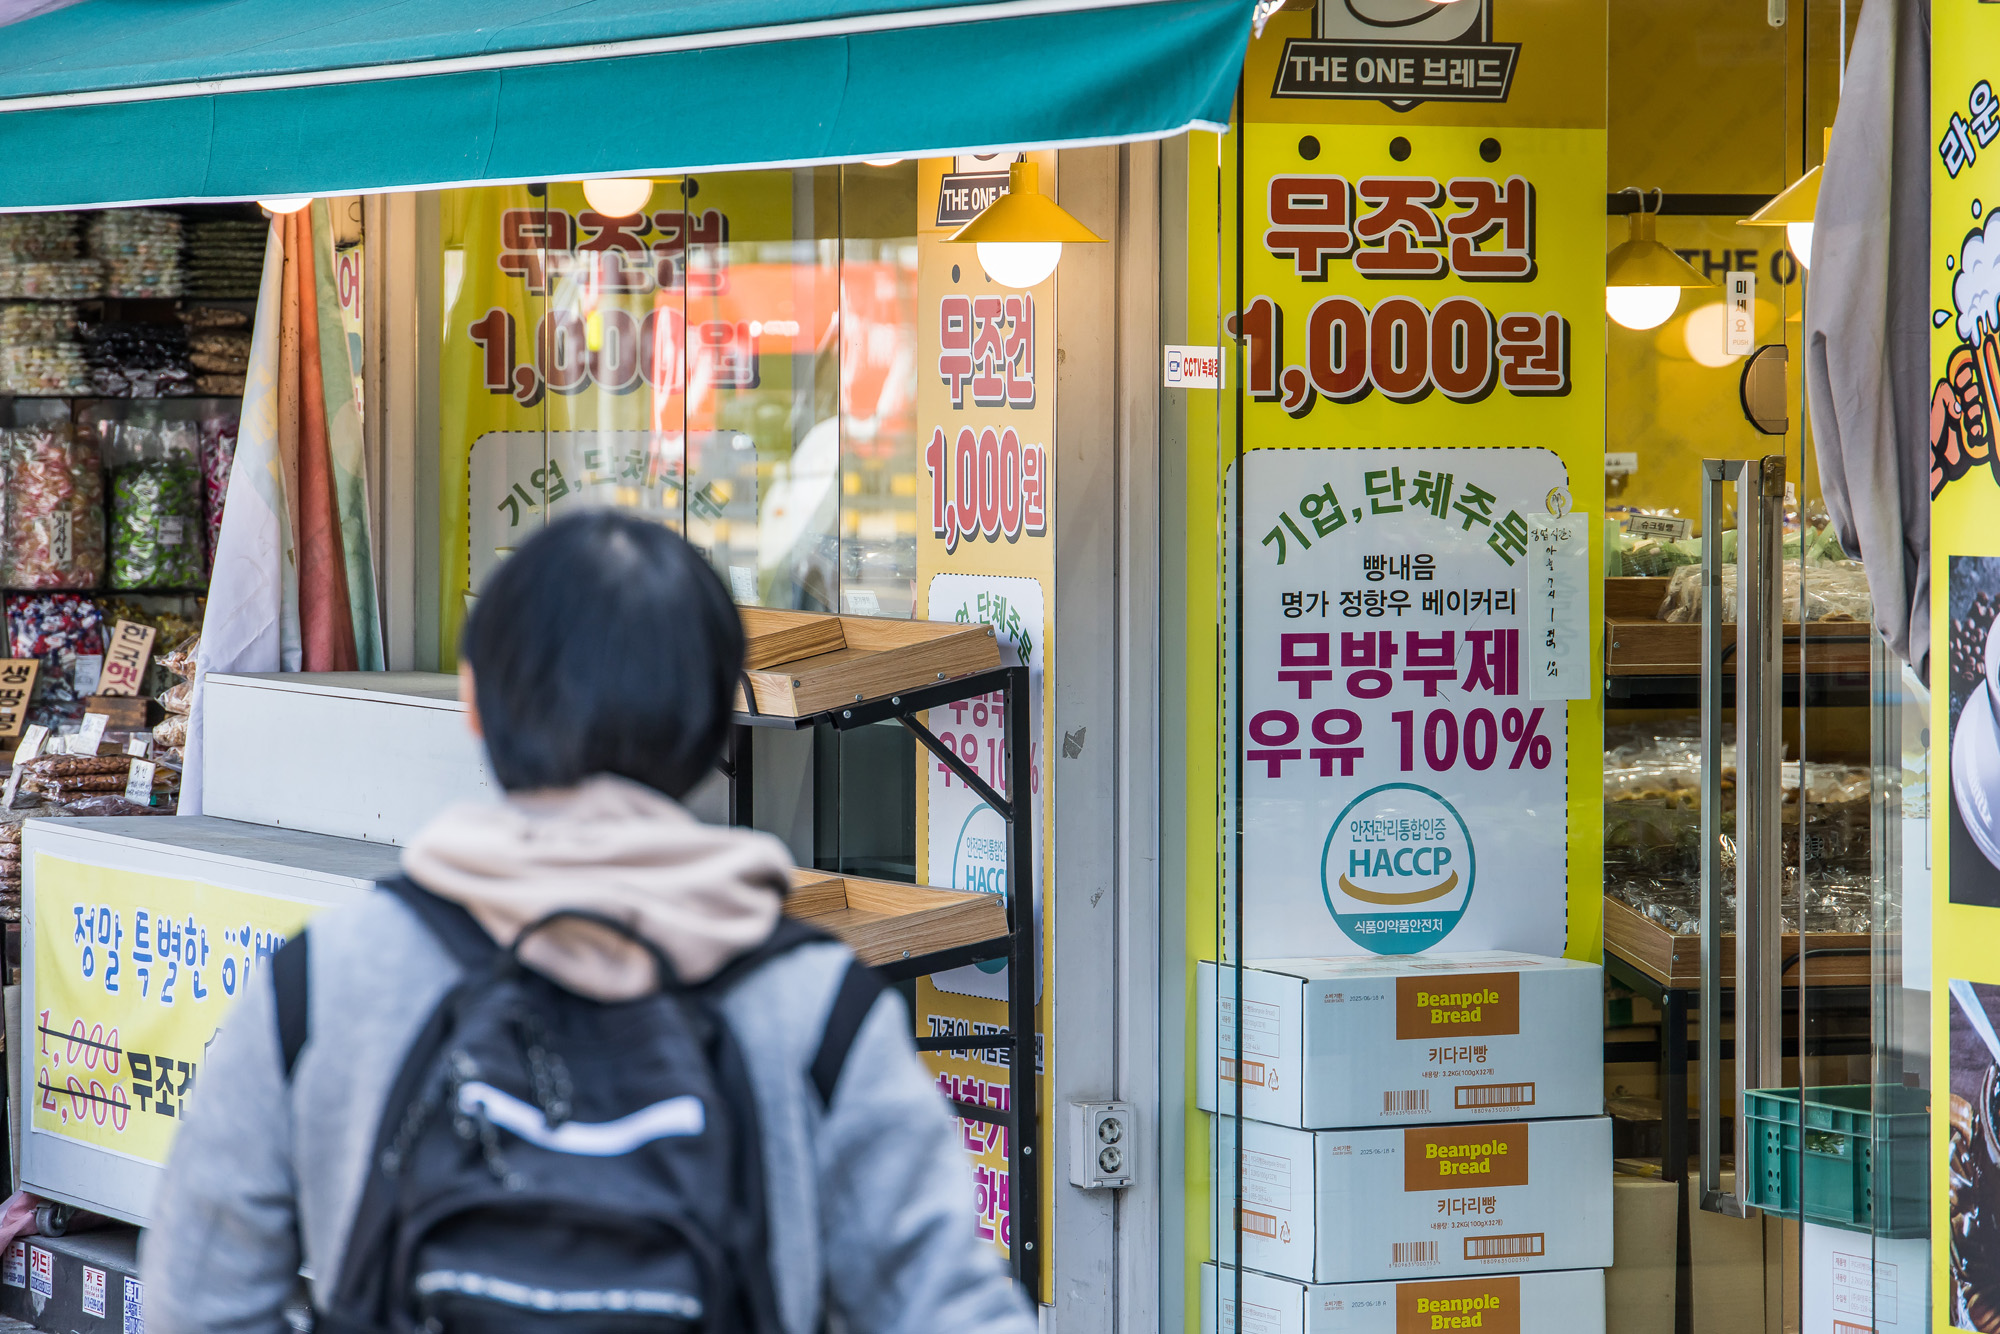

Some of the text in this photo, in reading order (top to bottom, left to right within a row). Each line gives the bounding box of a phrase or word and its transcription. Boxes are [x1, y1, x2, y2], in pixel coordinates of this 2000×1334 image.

[1290, 56, 1503, 88] THE ONE 브레드
[944, 187, 969, 211] THE
[1263, 174, 1532, 277] 무조건
[497, 208, 729, 297] 무조건
[1736, 280, 1747, 332] 미세요
[938, 292, 1034, 404] 무조건
[1224, 295, 1564, 412] 1,000원
[925, 424, 1045, 551] 1,000원
[1261, 466, 1529, 567] 기업,단체주문
[1363, 553, 1436, 581] 빵내음
[1281, 588, 1516, 618] 명가 정항우 베이커리
[1277, 628, 1520, 700] 무방부제
[1246, 706, 1552, 779] 우유 100%
[1350, 818, 1447, 842] 안전관리통합인증
[1349, 846, 1452, 878] HACCP
[966, 864, 1007, 898] HACC
[1354, 918, 1444, 935] 식품의약품안전처
[73, 905, 123, 993] 정말
[132, 909, 210, 1004] 특별한
[1416, 988, 1499, 1009] Beanpole
[1430, 1007, 1482, 1025] Bread
[38, 1010, 121, 1075] 1,000
[1428, 1044, 1488, 1065] 키다리빵
[38, 1066, 130, 1132] 2,000
[1425, 1140, 1508, 1160] Beanpole
[1439, 1158, 1491, 1177] Bread
[1437, 1195, 1497, 1216] 키다리빵
[32, 1250, 47, 1274] 카드
[1416, 1293, 1500, 1314] Beanpole
[1430, 1312, 1482, 1331] Bread
